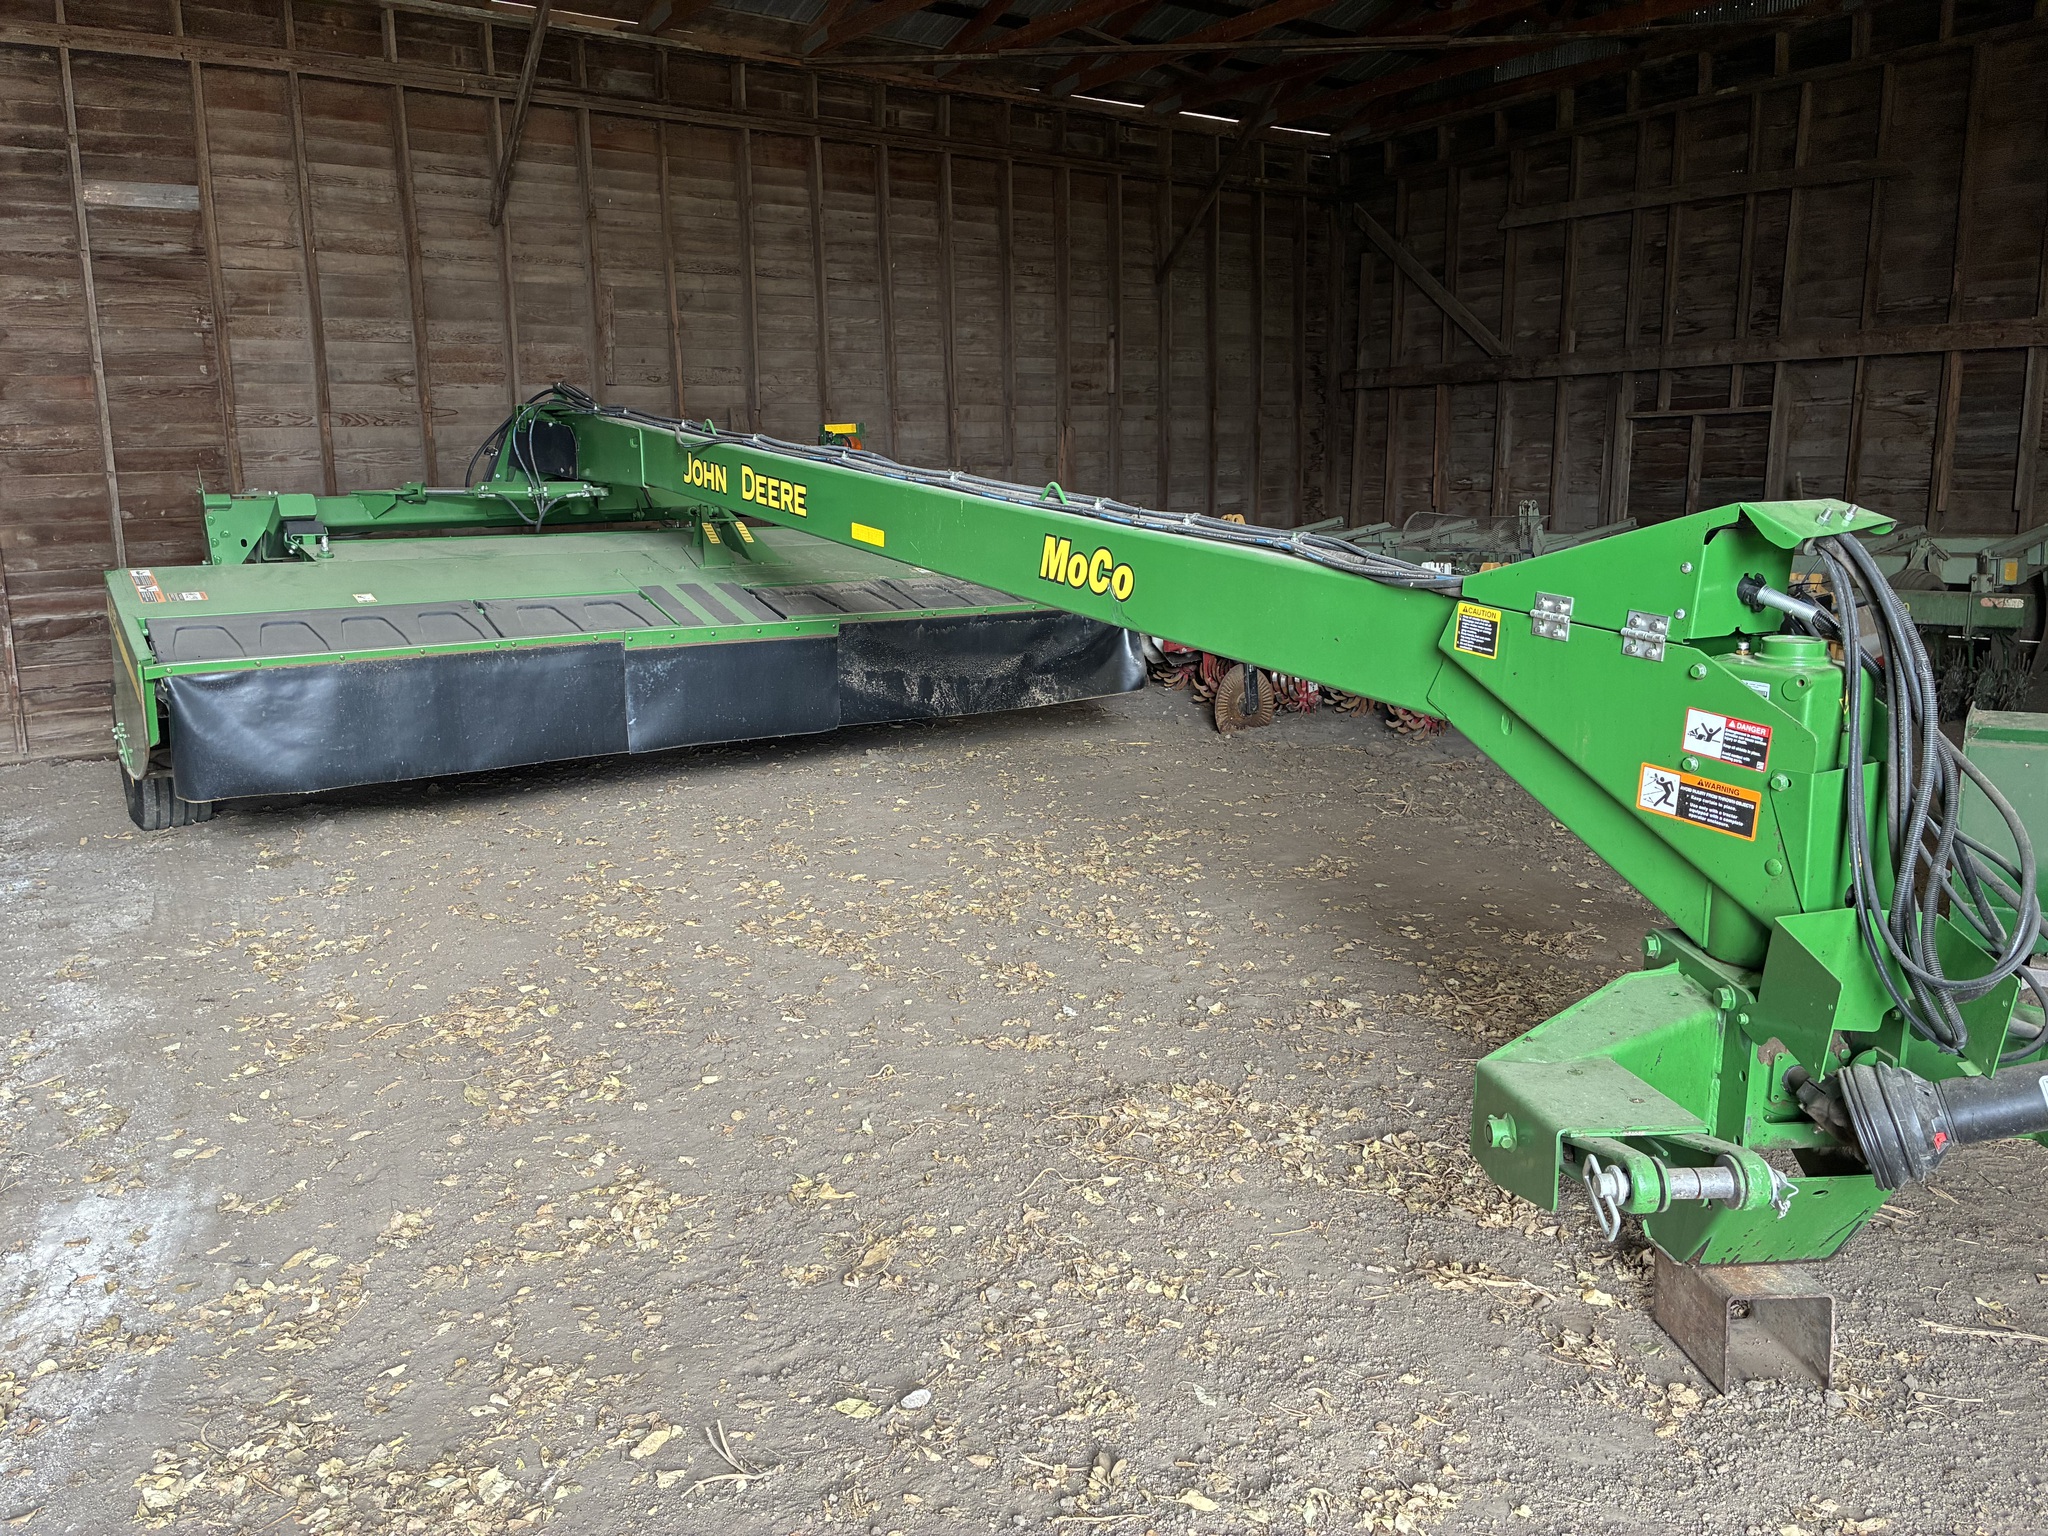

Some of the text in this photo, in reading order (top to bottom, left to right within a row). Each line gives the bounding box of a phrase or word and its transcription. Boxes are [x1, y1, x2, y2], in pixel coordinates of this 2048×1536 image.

[683, 451, 808, 518] JOHN DEERE
[1039, 533, 1135, 602] MoCo
[1469, 607, 1497, 619] CAUTION
[1737, 723, 1767, 736] DANGER
[1704, 781, 1740, 796] WARNING
